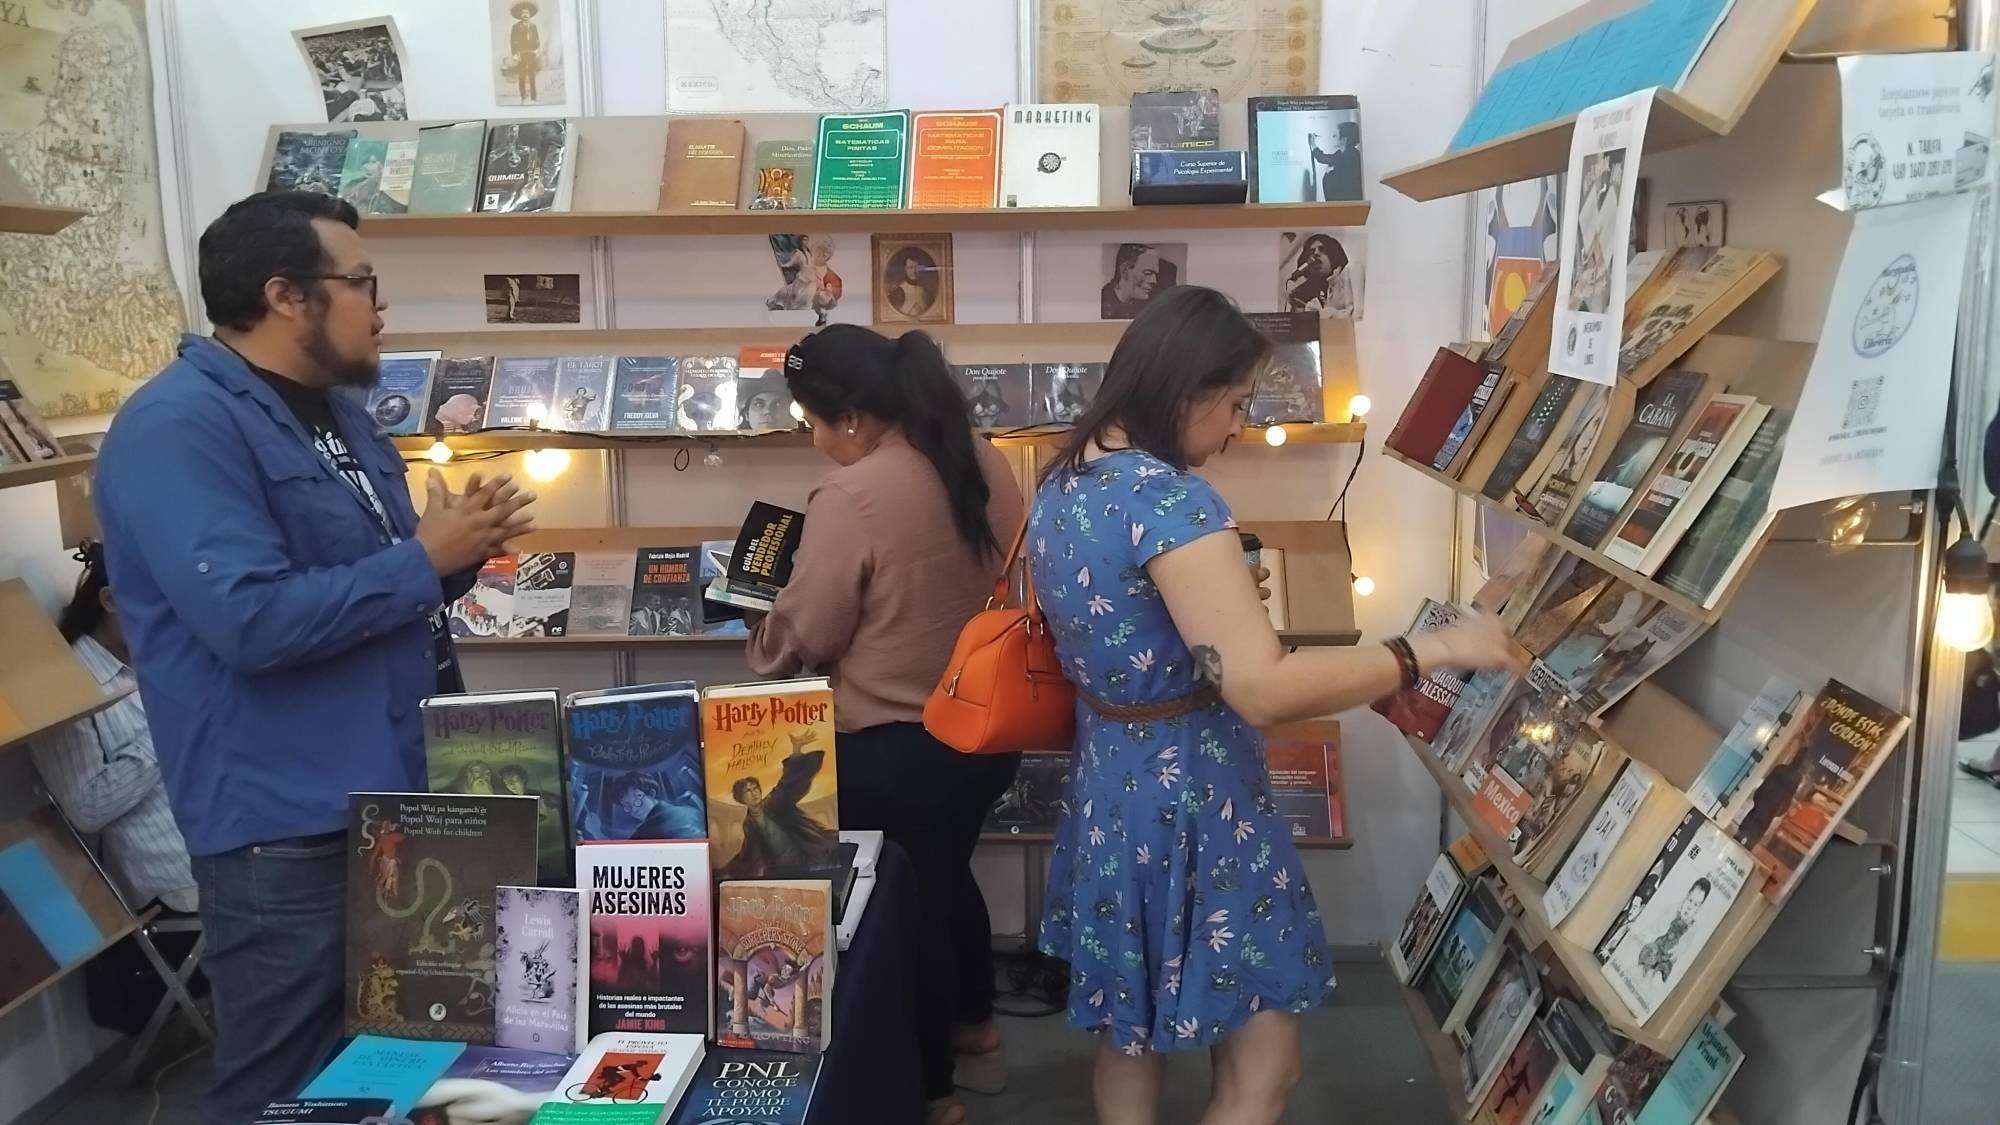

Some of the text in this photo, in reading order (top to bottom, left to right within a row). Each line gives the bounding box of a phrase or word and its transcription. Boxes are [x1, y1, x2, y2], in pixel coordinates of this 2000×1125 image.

[1014, 110, 1092, 124] MARKETING
[842, 122, 884, 130] SCHAUM
[1200, 166, 1234, 174] Experimental
[488, 173, 525, 182] QUIMICA
[965, 367, 1007, 377] Don Quijote
[1662, 392, 1675, 408] LA
[750, 522, 778, 573] VENDEDOR
[761, 514, 793, 577] PROFESIONAL
[742, 538, 760, 572] GUÍA DEL
[648, 563, 688, 573] UN HOMBRE
[643, 573, 690, 584] DE CONFIANZA
[1432, 672, 1466, 695] JACQUI
[571, 701, 690, 740] Harry Potter
[712, 697, 828, 732] Harry Potter
[431, 705, 551, 739] Harry Potter
[1483, 779, 1520, 824] Mexico
[400, 803, 419, 813] Popol
[421, 804, 436, 813] Wuj
[400, 814, 487, 826] Popol Wuj para niños
[455, 828, 483, 836] children
[593, 866, 685, 889] MUJERES
[592, 891, 686, 915] ASESINAS
[525, 913, 553, 926] Lewis
[521, 926, 554, 938] Carroll
[648, 994, 685, 1002] impactantes
[506, 1005, 529, 1017] Alicia
[530, 1009, 540, 1017] en
[644, 1002, 657, 1010] más
[658, 1002, 682, 1010] brutales
[503, 1015, 569, 1032] de las Maravillas
[616, 1019, 666, 1030] JAMIE KING
[753, 1031, 810, 1045] ROWLING
[716, 1061, 800, 1078] PNL
[712, 1078, 798, 1088] CONOCE
[720, 1087, 782, 1098] CÓMO
[706, 1097, 792, 1107] TE PUEDE
[262, 1108, 314, 1116] TSUGUMI
[702, 1106, 782, 1117] APOYAR
